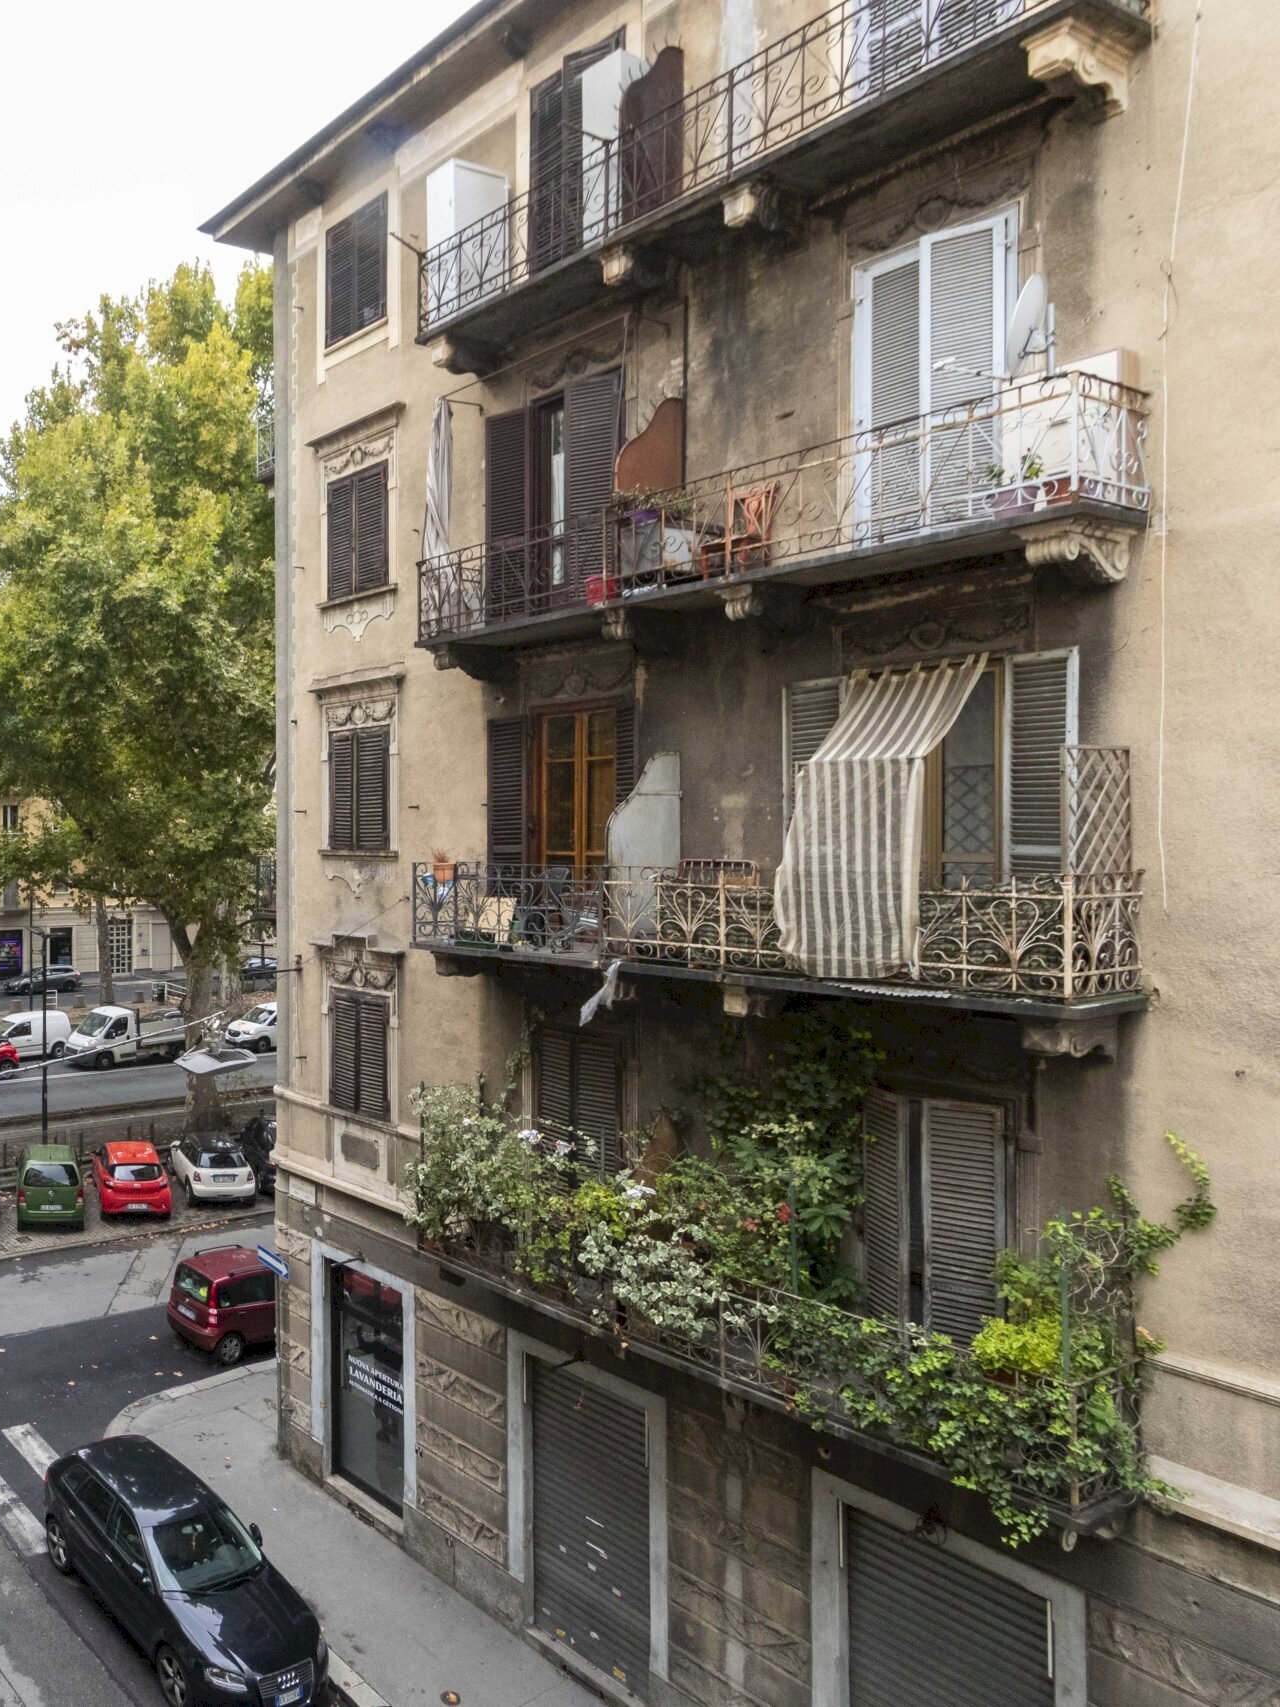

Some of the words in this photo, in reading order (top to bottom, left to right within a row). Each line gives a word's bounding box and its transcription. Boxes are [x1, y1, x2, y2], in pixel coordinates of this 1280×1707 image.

[348, 1354, 370, 1372] NUOVA
[370, 1367, 404, 1392] APERTURA
[349, 1366, 402, 1404] LAVANDERIA
[348, 1379, 378, 1400] AUTOMATICA
[382, 1400, 404, 1417] GETTONI
